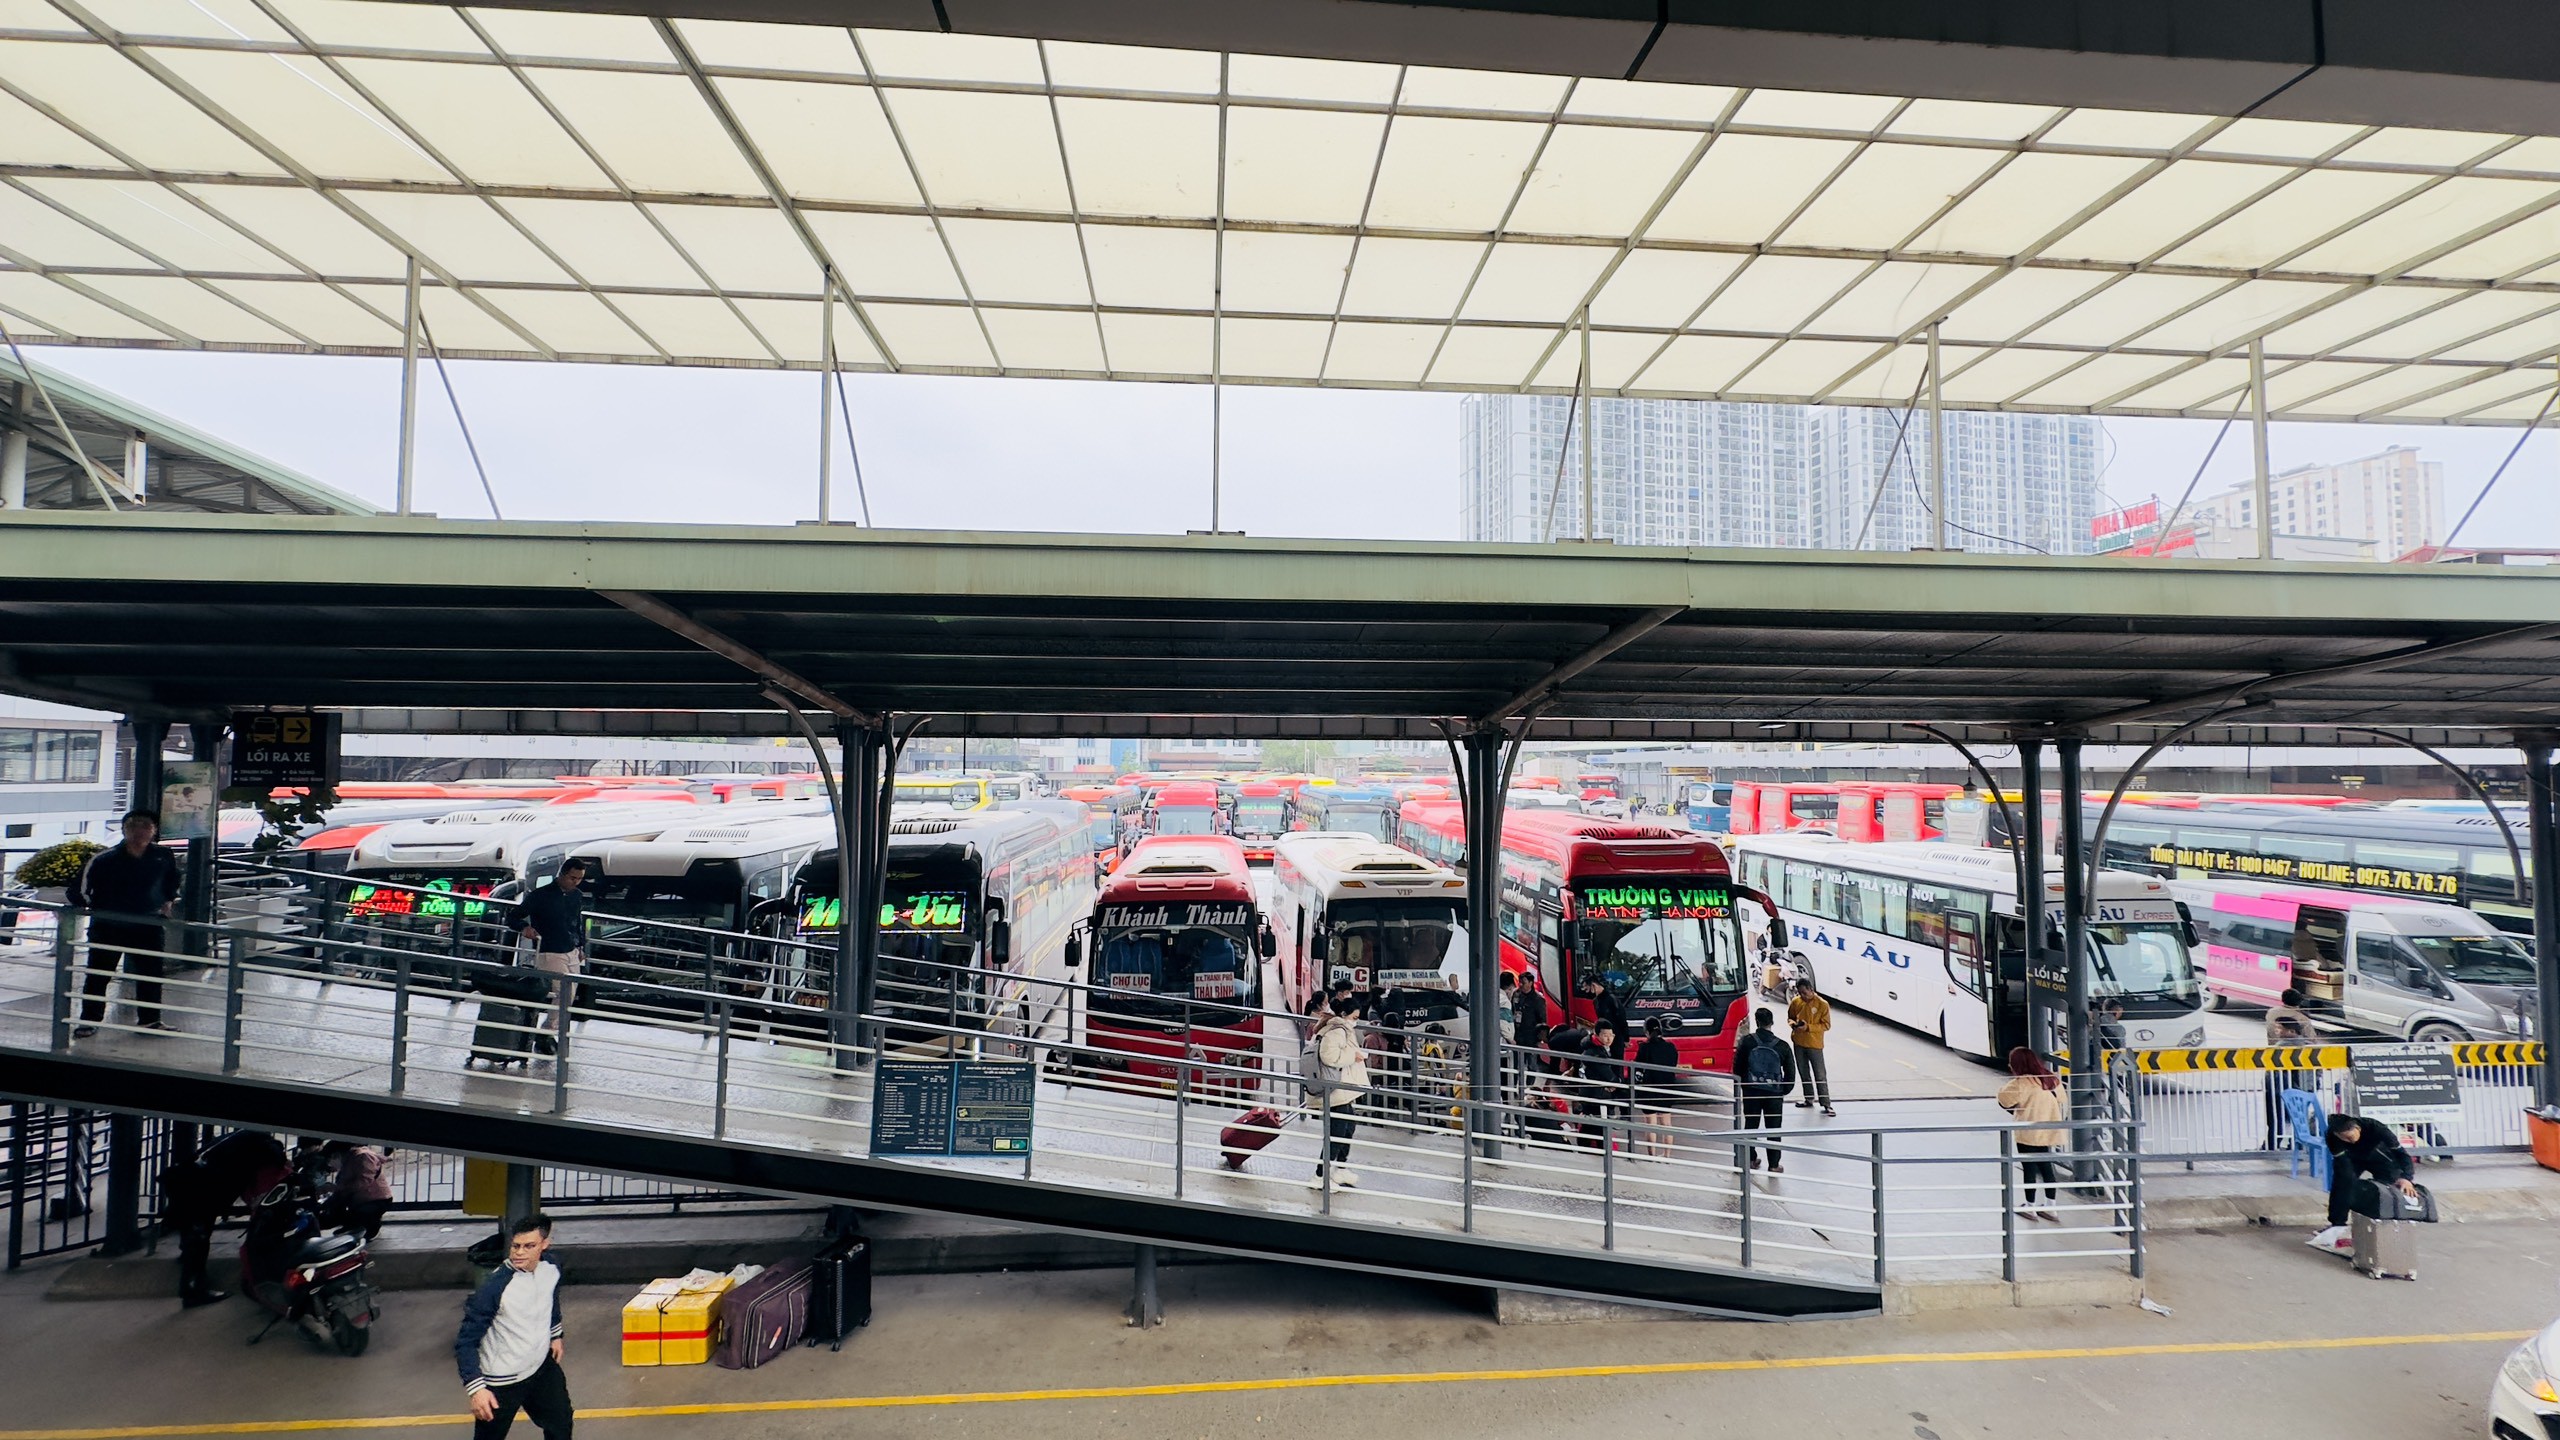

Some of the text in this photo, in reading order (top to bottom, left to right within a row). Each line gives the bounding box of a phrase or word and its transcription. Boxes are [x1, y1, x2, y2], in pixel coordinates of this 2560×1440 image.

[247, 748, 311, 762] LỐI RA XE
[2150, 842, 2174, 864] TỔNG
[2177, 847, 2193, 866] ĐÀI
[2195, 850, 2215, 870] ĐẶT
[2235, 855, 2262, 874] 1900
[2263, 858, 2292, 877] 6467
[2299, 862, 2354, 883] HOTLINE:
[2356, 867, 2457, 894] 0975.76.76.76
[1806, 868, 1825, 882] TẬN
[1828, 871, 1850, 886] NHÀ
[1858, 878, 1879, 892] TRẢ
[1883, 883, 1908, 898] TẬN
[1585, 886, 1729, 907] TRƯỜNG VỊNH
[908, 895, 961, 926] Vũ
[1101, 904, 1247, 927] Khánh Thành
[1586, 906, 1608, 918] HÀ
[1684, 905, 1711, 918] NỘI
[2100, 906, 2125, 921] ÂU
[1793, 925, 1910, 969] HẢI ÂU
[2209, 953, 2249, 971] mobi
[1112, 975, 1150, 988] CHỢ LỤC
[1355, 969, 1368, 982] C
[1380, 971, 1393, 979] NAM
[2034, 965, 2066, 983] LỐI RA
[1195, 983, 1233, 999] THÁI BÌNH
[2035, 979, 2067, 992] WAY OUT
